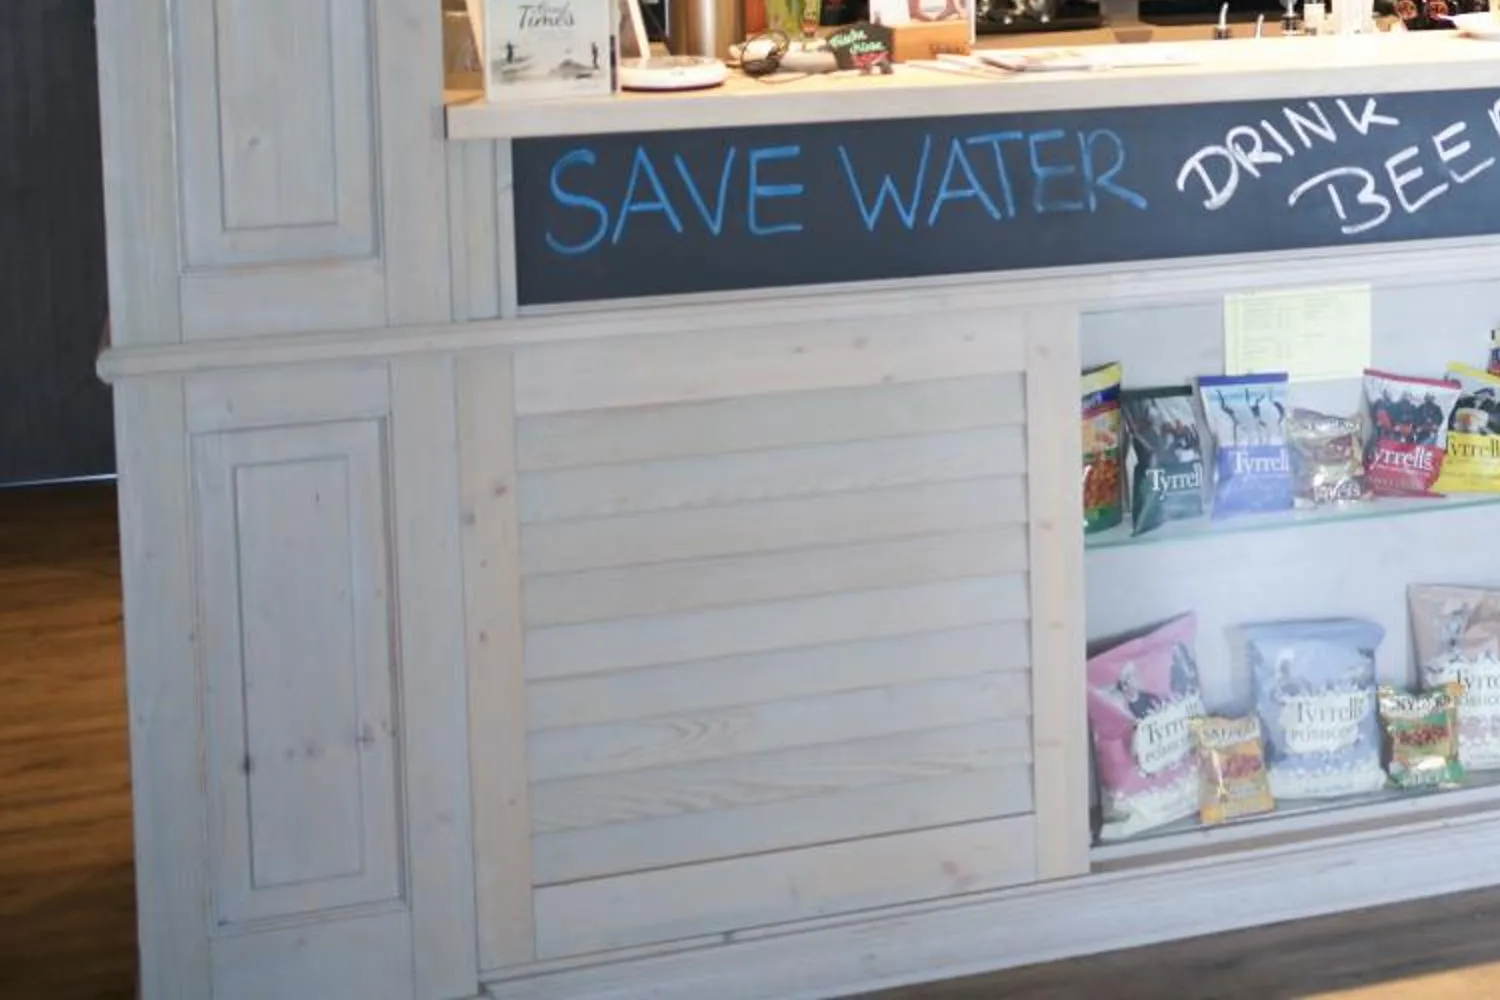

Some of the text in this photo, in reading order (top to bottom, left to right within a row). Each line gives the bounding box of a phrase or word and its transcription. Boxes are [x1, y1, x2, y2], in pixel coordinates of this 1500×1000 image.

[517, 3, 576, 30] Times
[545, 127, 1148, 255] SAVE WATER
[1175, 98, 1400, 210] DRINK
